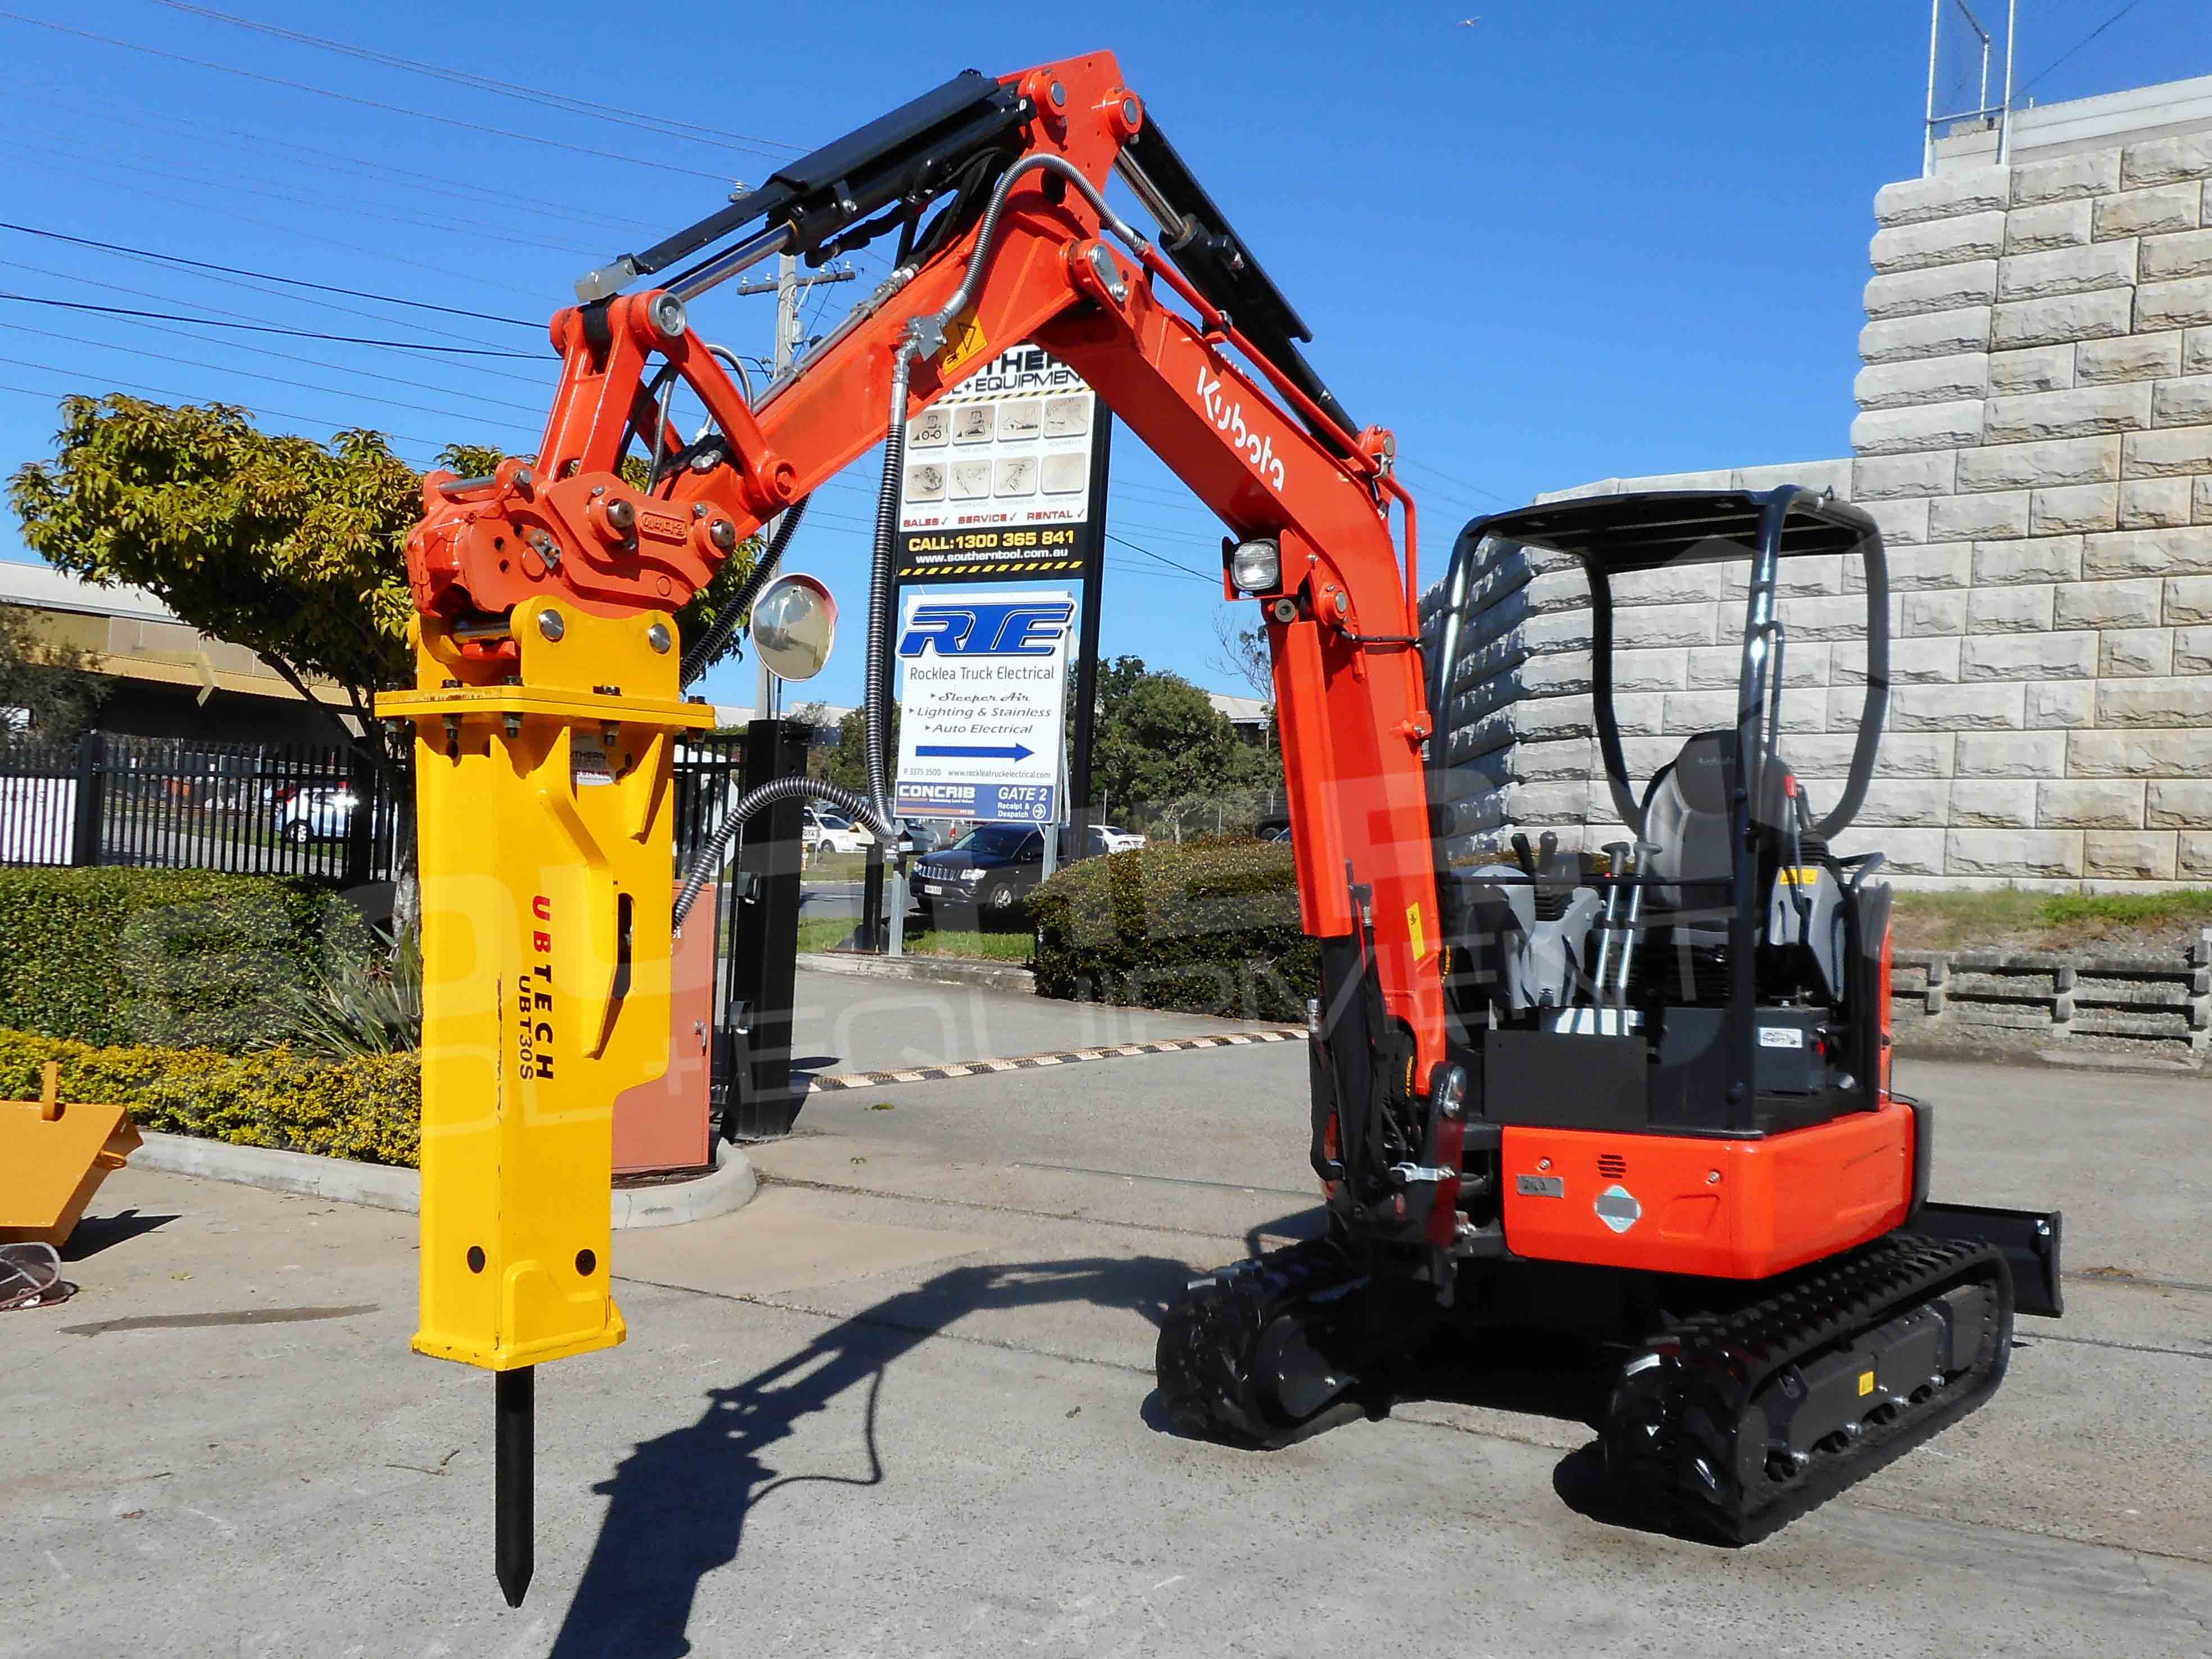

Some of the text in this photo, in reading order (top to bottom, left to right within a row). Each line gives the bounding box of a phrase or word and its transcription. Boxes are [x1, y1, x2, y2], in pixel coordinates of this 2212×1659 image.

[975, 370, 1080, 392] EQUIPMEN
[1196, 365, 1285, 492] Kubota
[903, 510, 1073, 527] SALES SERVICE RENTAL
[1002, 532, 1037, 547] 365
[1041, 530, 1074, 545] 841
[916, 549, 1068, 564] www.southerntool.com.au
[898, 601, 1071, 656] RTE
[910, 665, 1054, 680] Rocklea Truck Electrical
[938, 692, 1030, 703] Sleeper Air
[917, 707, 1052, 719] Lighting & Stainless
[932, 724, 1033, 734] Auto Electrical
[948, 769, 1051, 779] www.rockleatruckelectrical.com
[898, 785, 1047, 801] CONCRIB GATE 2
[518, 976, 534, 1080] UBT30S
